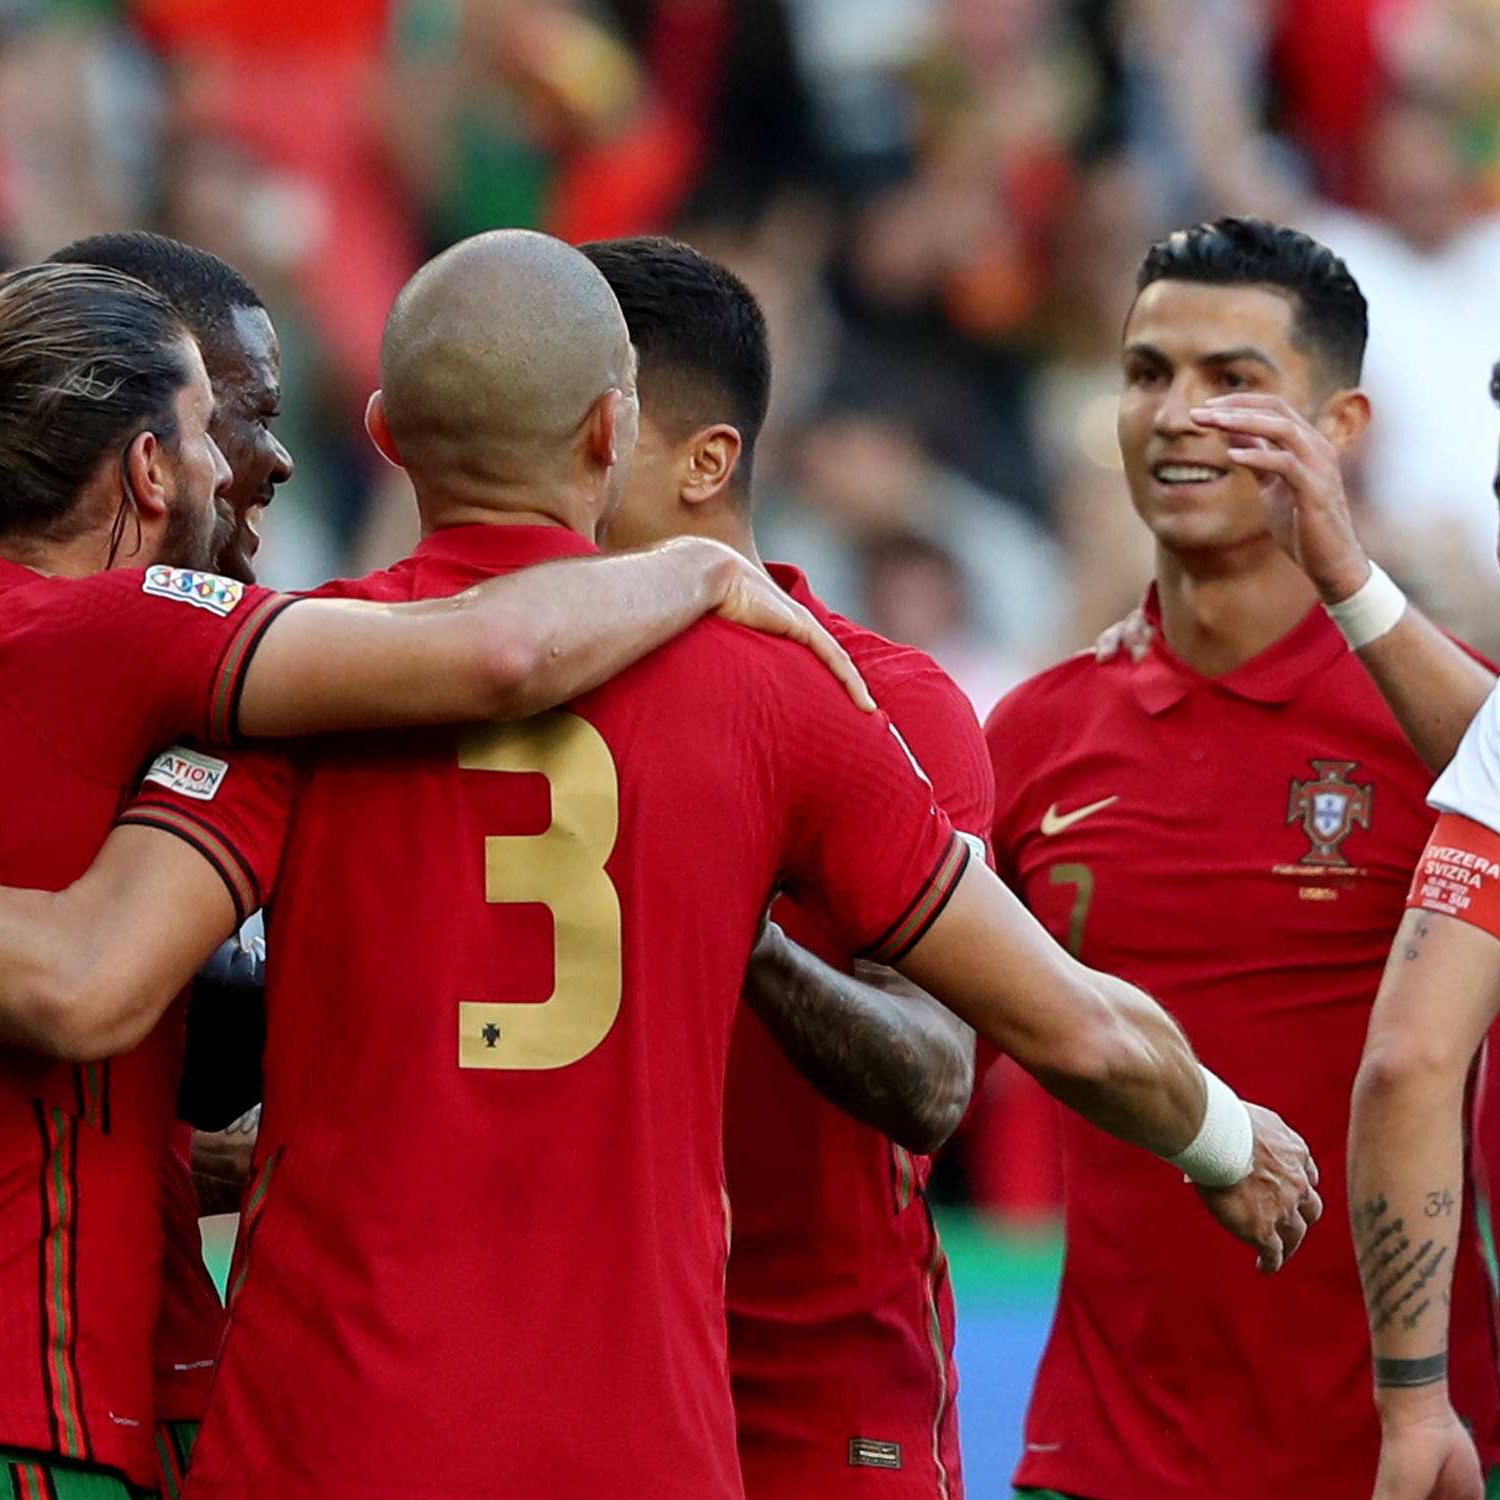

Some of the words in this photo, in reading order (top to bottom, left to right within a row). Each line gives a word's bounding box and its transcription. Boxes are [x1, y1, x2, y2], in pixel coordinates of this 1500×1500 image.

[458, 711, 621, 1070] 3
[1424, 860, 1482, 889] SVIZRA
[1425, 846, 1500, 879] SVIZZERA
[1049, 863, 1094, 959] 7
